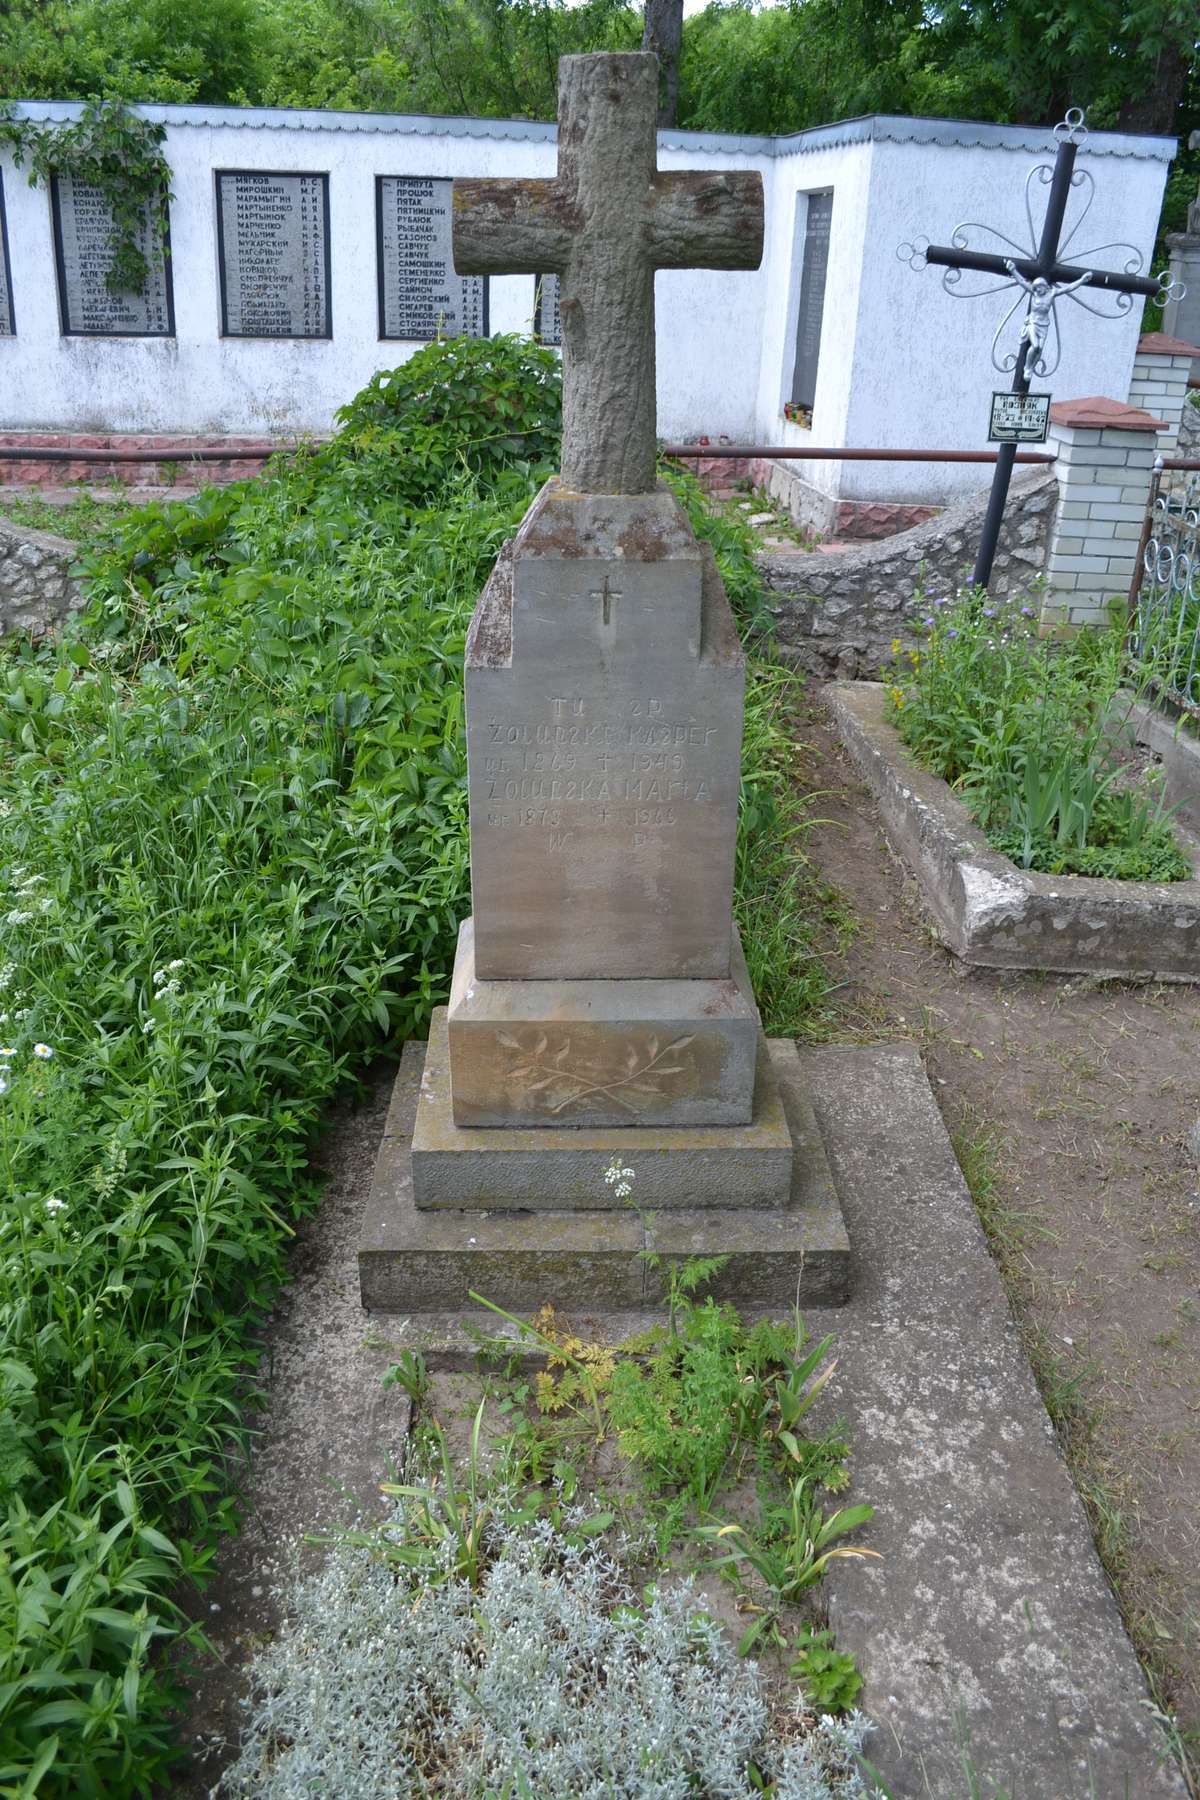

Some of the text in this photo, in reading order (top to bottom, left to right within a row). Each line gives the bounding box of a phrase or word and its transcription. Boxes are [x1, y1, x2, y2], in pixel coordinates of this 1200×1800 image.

[396, 180, 434, 189] ПРИПУТА
[236, 186, 285, 195] МИРОШКИН
[397, 198, 423, 206] ПЯТАК
[398, 242, 430, 250] САВЧУК
[398, 251, 429, 259] САВЧУК
